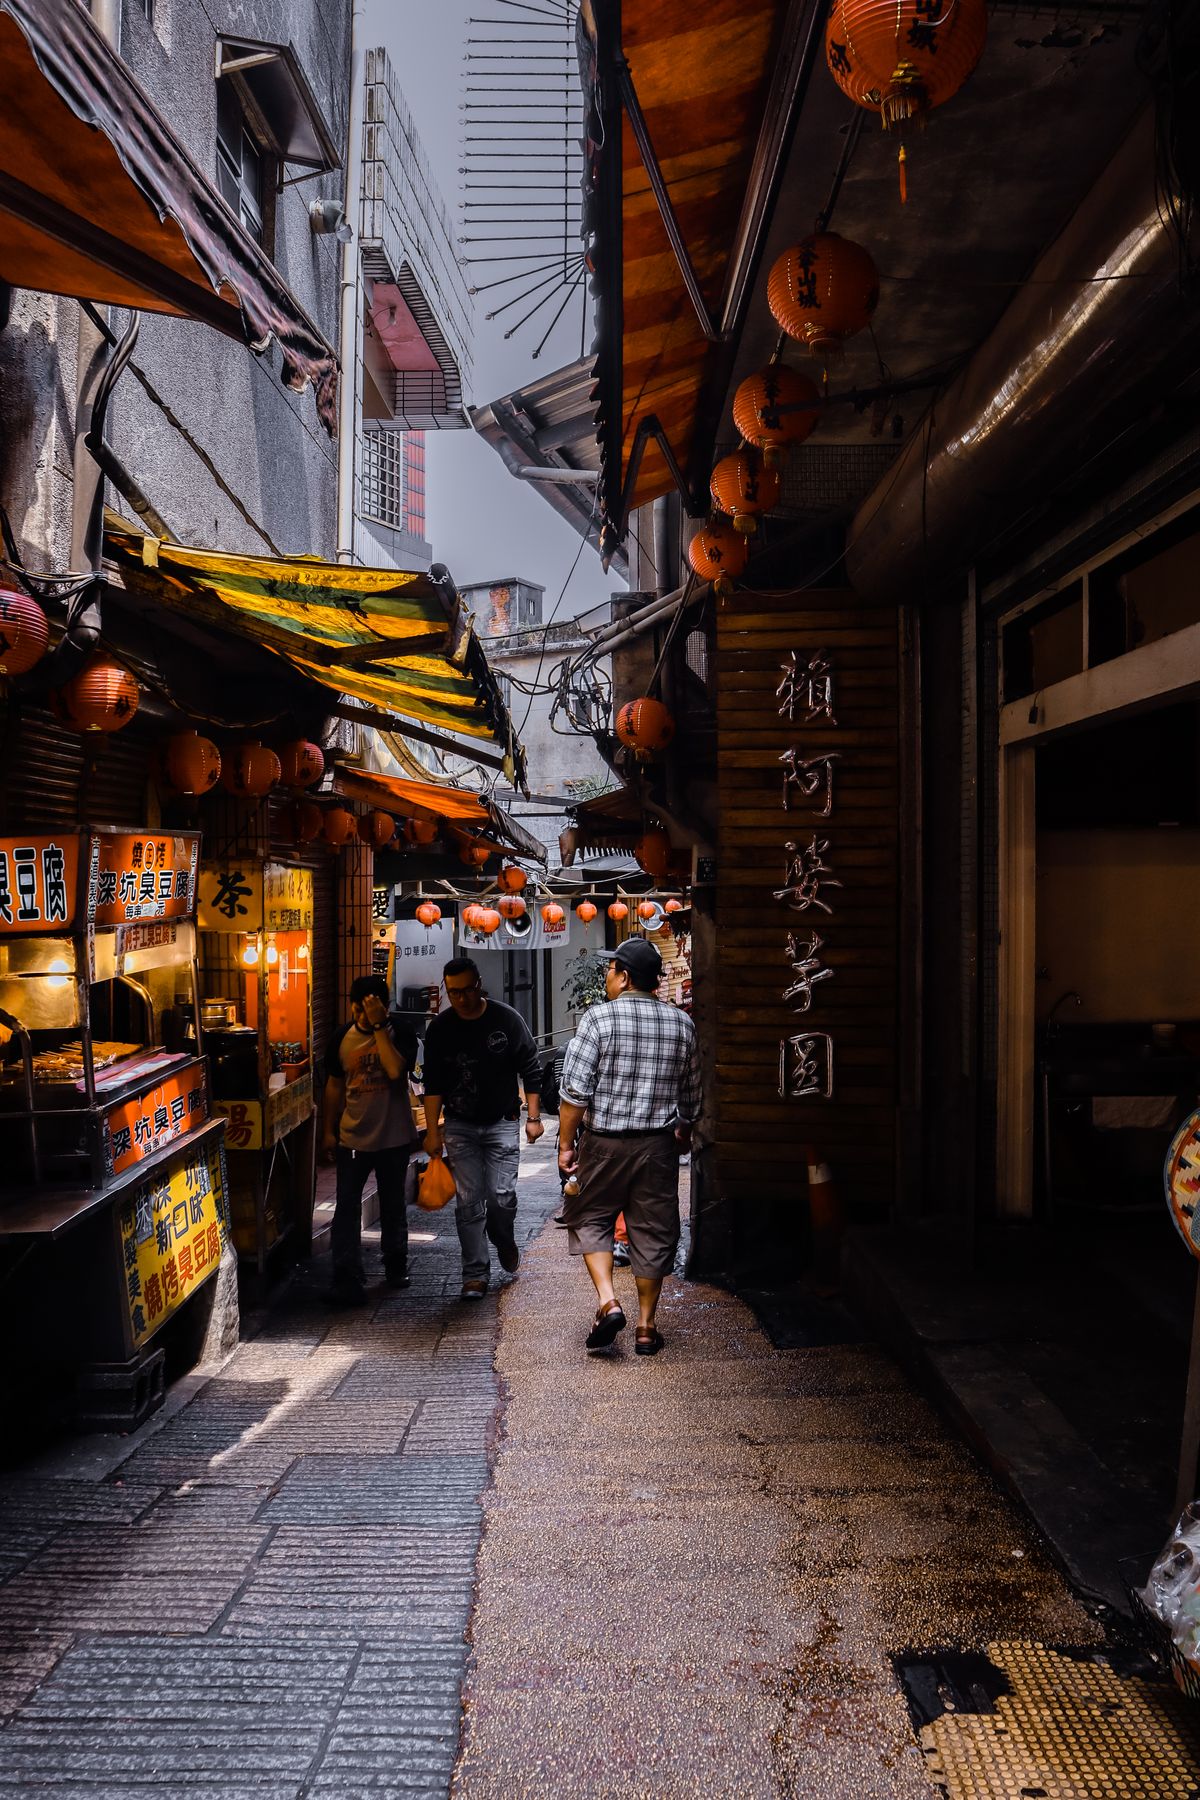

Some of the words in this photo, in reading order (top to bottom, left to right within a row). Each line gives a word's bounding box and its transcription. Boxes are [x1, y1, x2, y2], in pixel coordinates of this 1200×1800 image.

[97, 868, 189, 905] 深坑臭豆腐
[773, 647, 843, 1098] 賴阿婆芋圓
[404, 944, 436, 957] 中華郵政
[113, 1088, 201, 1159] 深坑臭豆腐
[156, 1191, 204, 1256] 新口味
[144, 1221, 220, 1321] 燒烤臭豆腐
